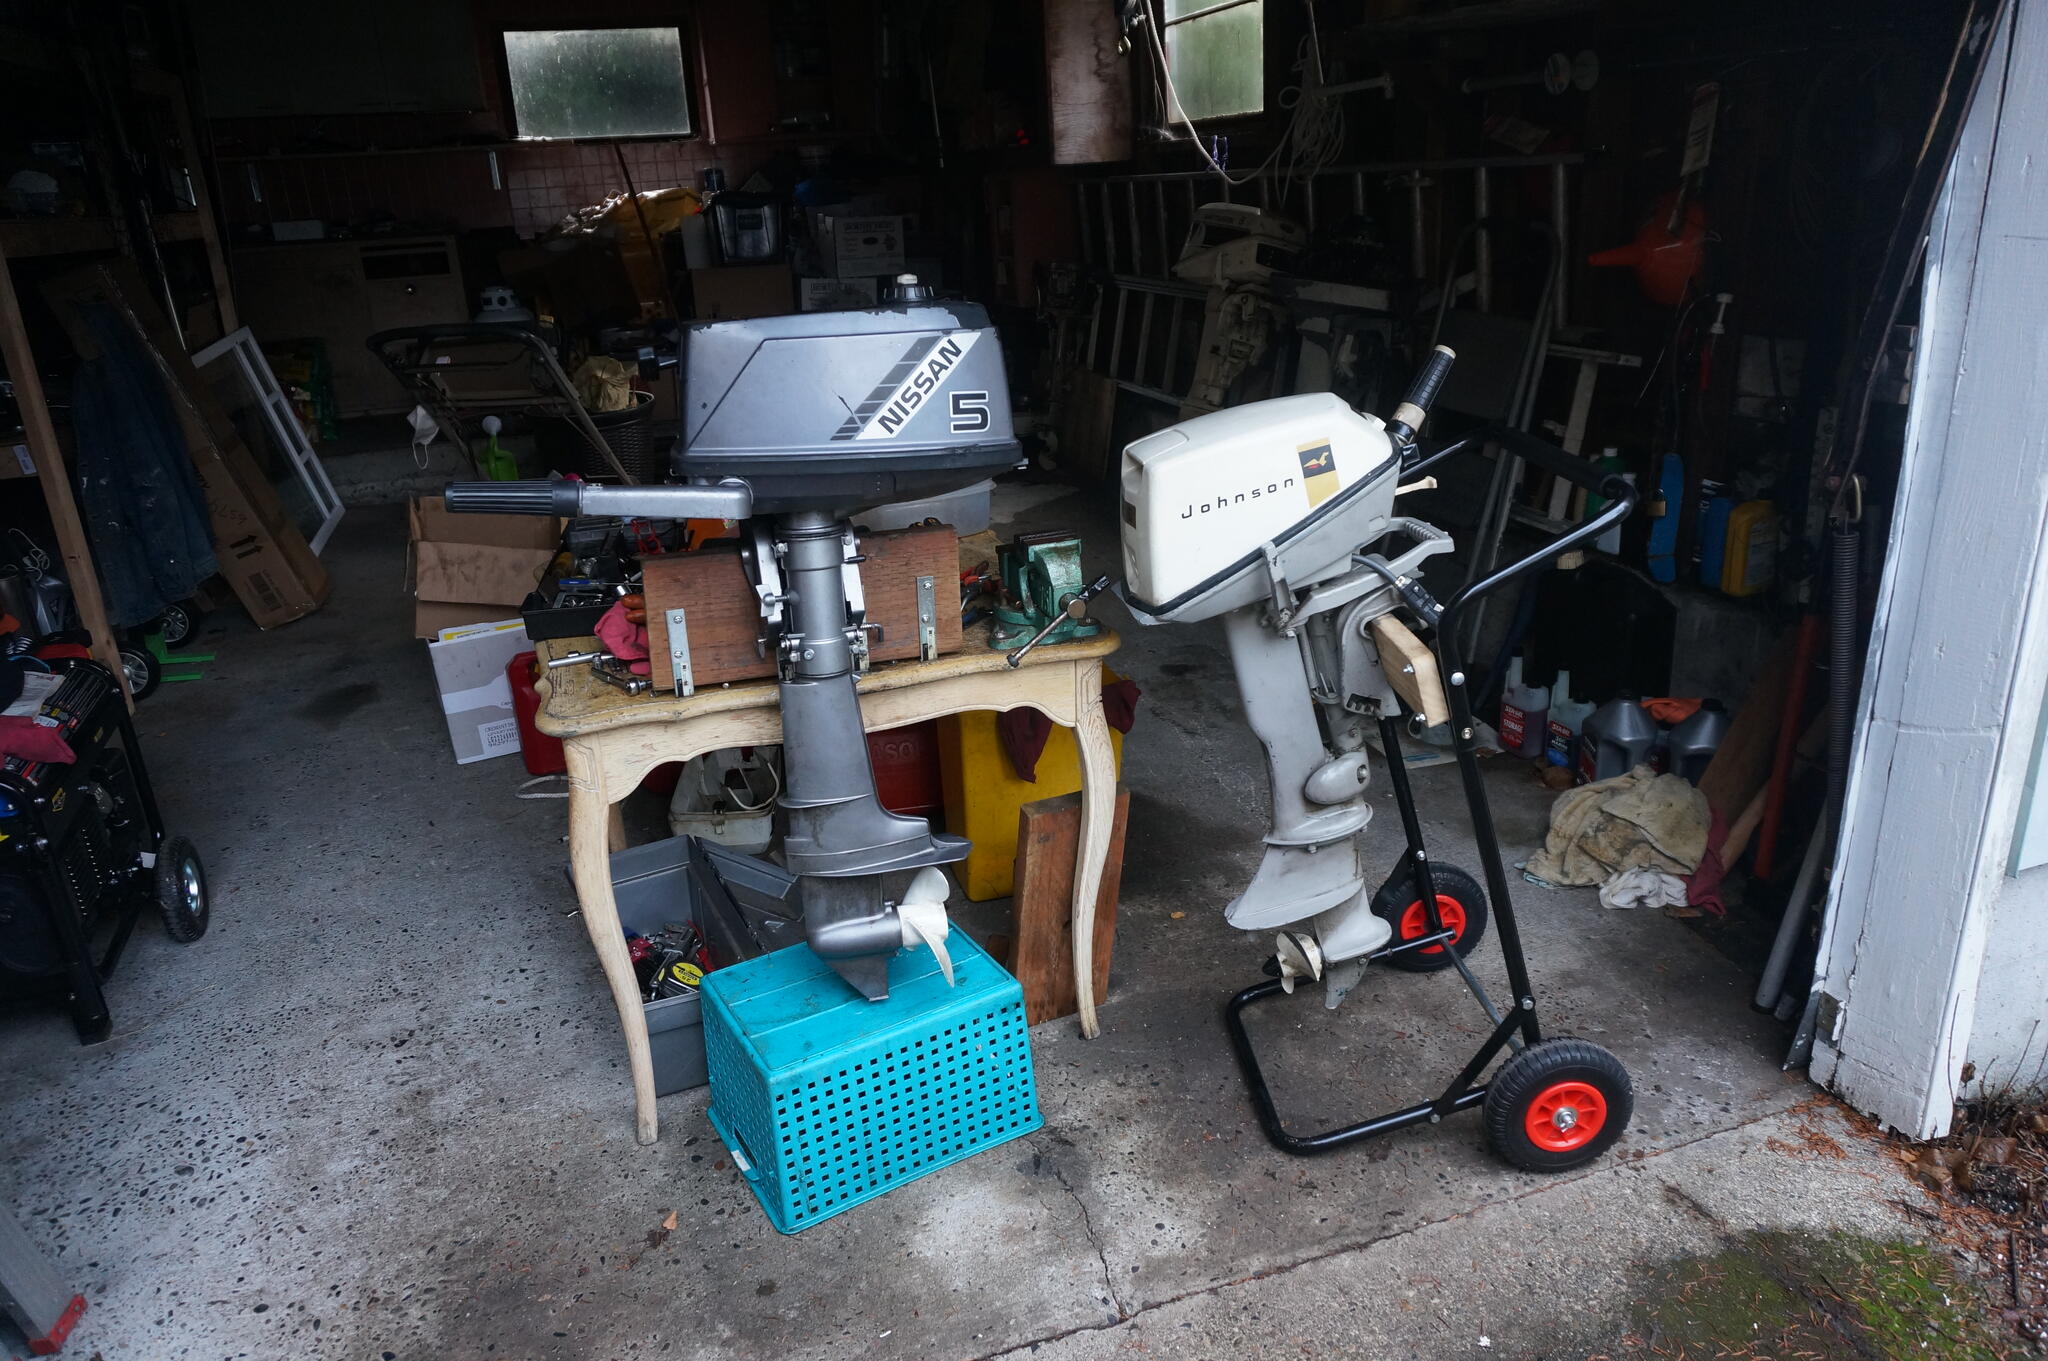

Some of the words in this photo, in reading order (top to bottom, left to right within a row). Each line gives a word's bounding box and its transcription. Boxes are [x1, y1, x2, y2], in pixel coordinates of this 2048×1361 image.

[878, 338, 962, 434] NISSAN
[949, 391, 990, 433] 5
[1181, 478, 1294, 519] Johnson
